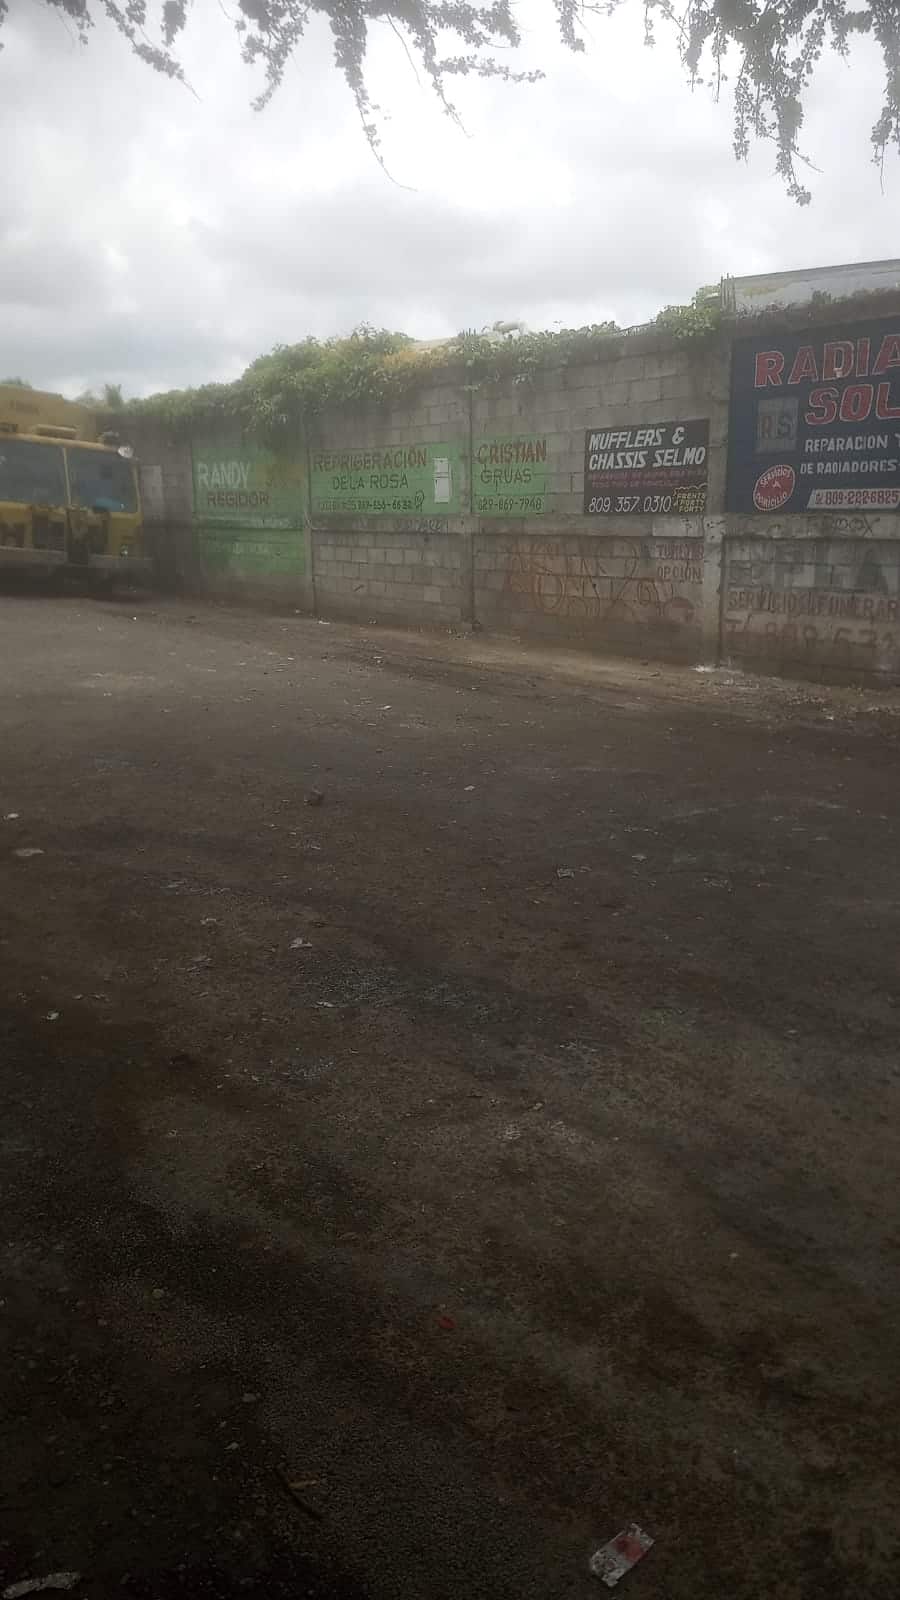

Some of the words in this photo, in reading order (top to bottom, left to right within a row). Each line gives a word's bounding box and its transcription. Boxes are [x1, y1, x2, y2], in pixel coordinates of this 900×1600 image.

[588, 428, 666, 451] MUFFLERS
[672, 427, 685, 444] &
[805, 435, 889, 452] REPARACION
[478, 440, 546, 464] CRISTIAN
[589, 451, 648, 471] CHASSIS
[652, 447, 706, 468] SELMO
[197, 461, 250, 489] RANDY
[480, 468, 532, 484] GRUAS
[800, 463, 813, 474] DE
[369, 473, 410, 489] ROSA
